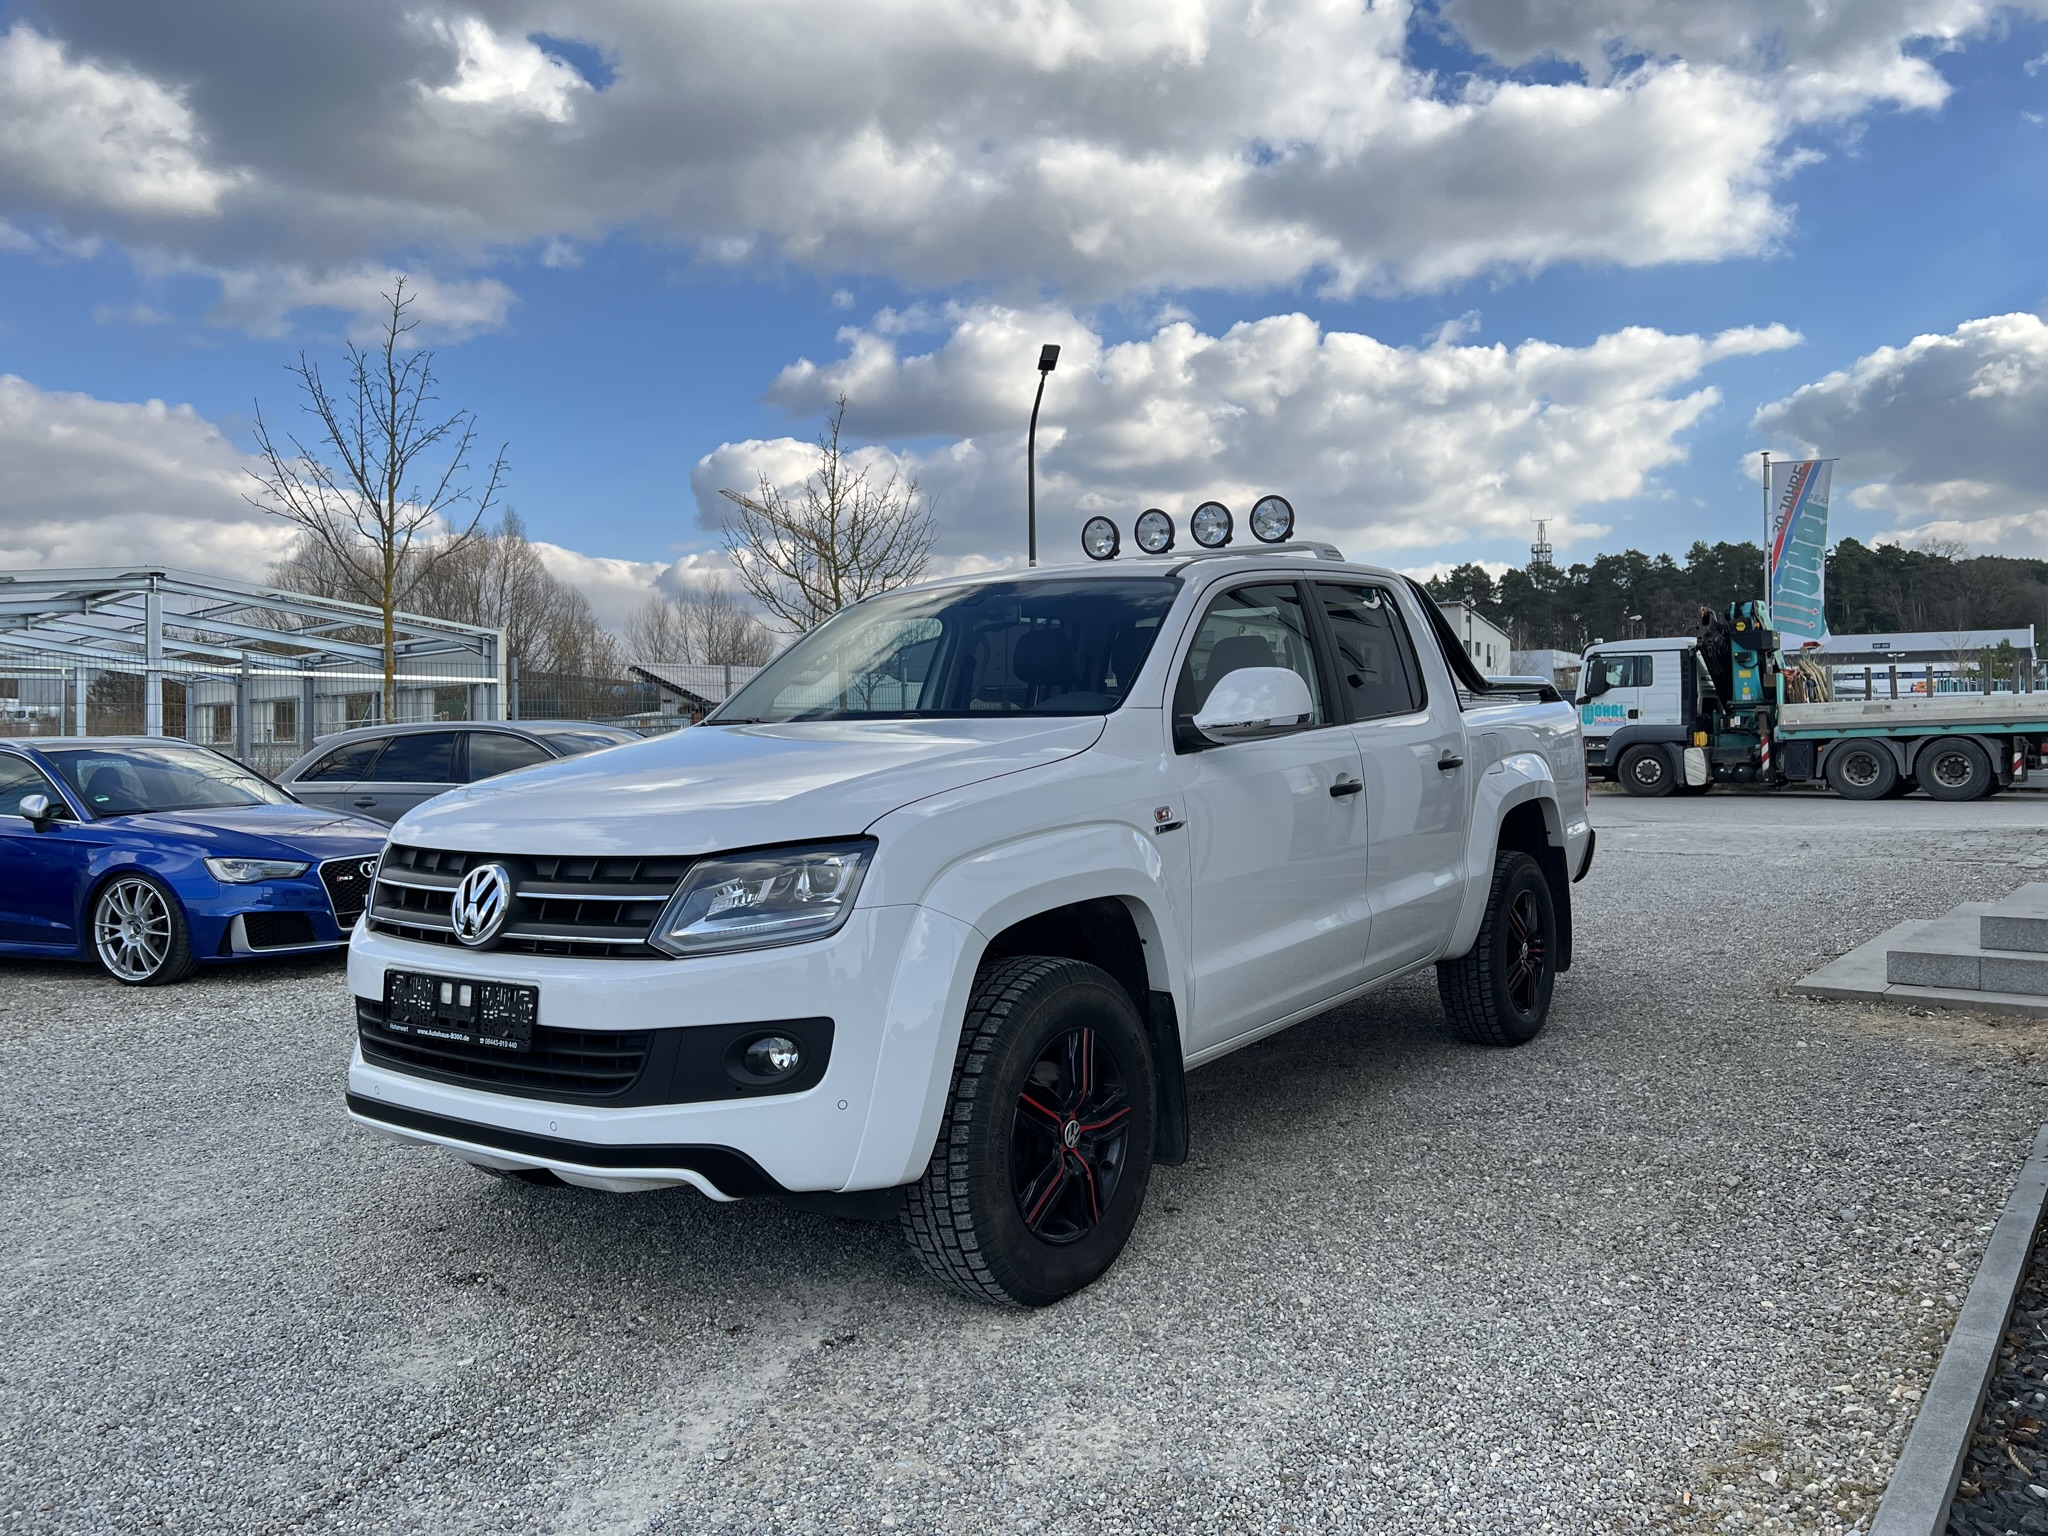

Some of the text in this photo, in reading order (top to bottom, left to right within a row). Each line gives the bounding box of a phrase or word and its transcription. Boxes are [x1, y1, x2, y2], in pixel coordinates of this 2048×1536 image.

[1773, 464, 1808, 535] 30 JAHRE
[416, 1028, 470, 1042] www.Autohaus-B300.de
[484, 1037, 508, 1048] 08443-919
[508, 1041, 518, 1049] 440
